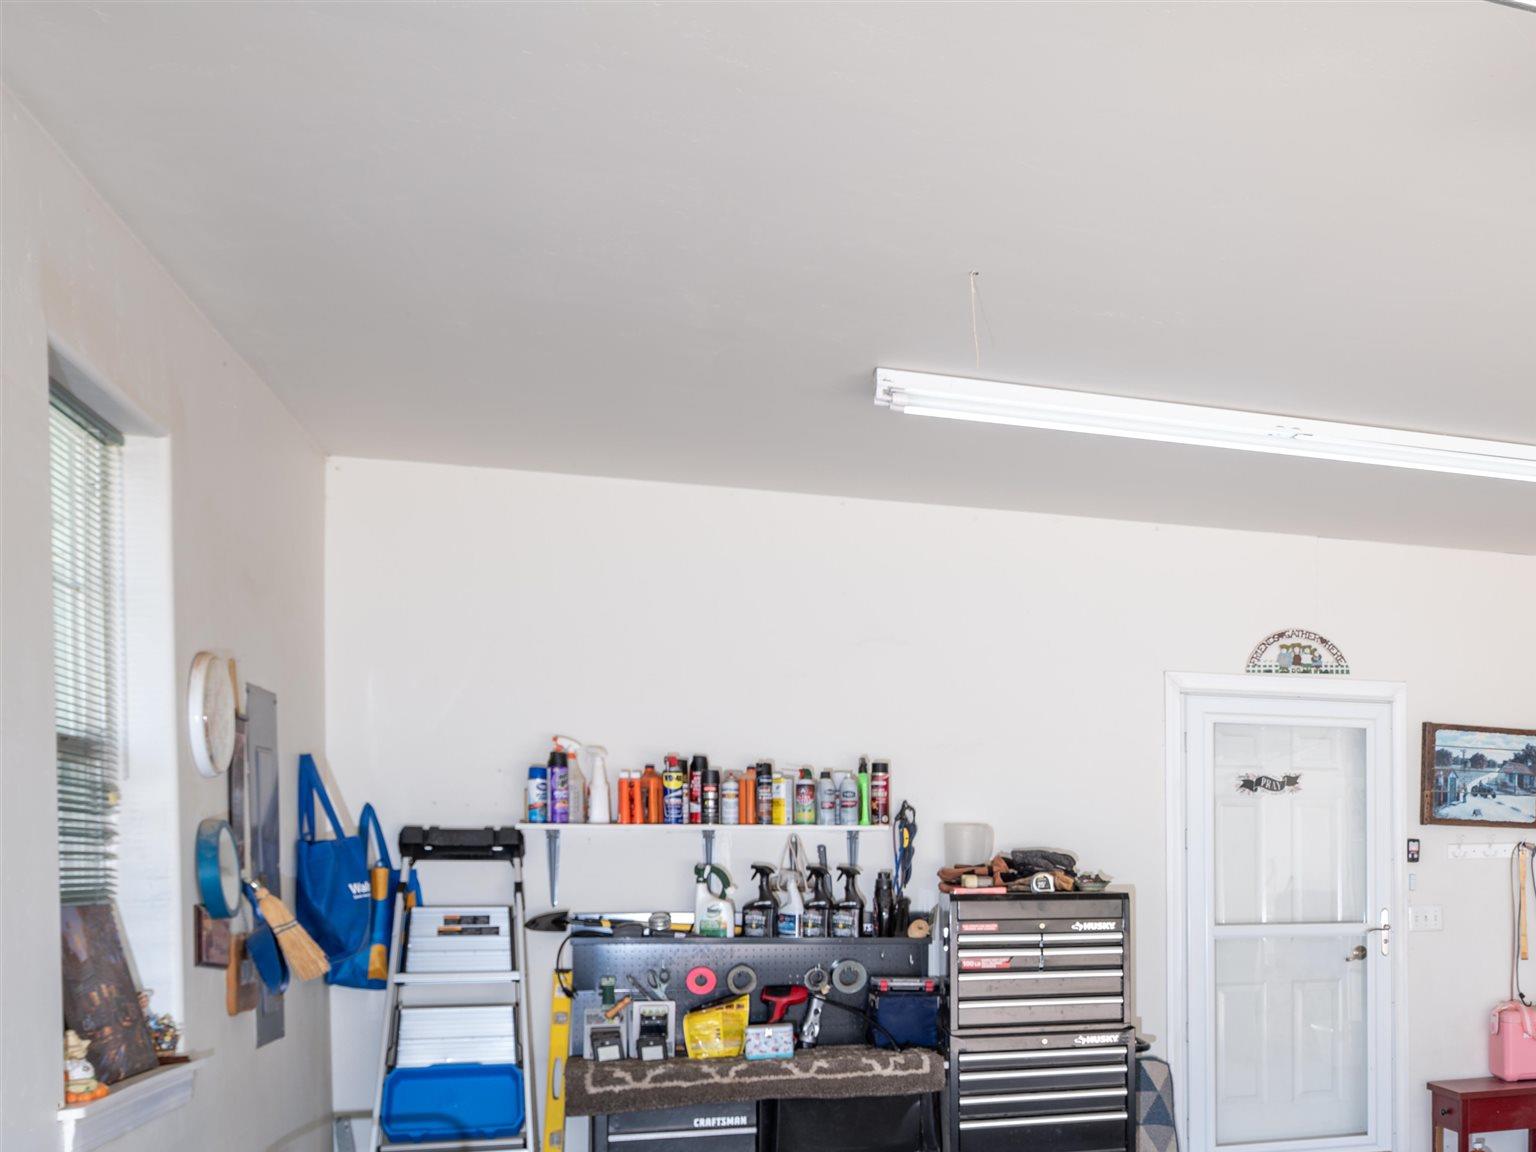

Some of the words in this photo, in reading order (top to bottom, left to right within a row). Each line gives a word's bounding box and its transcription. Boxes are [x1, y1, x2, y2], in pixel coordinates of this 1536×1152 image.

[1249, 632, 1281, 666] FRIENDS
[1284, 629, 1320, 642] GATHER
[1323, 640, 1347, 666] HERE
[1083, 921, 1116, 930] HUSKY
[1086, 1034, 1119, 1043] HUSKY
[693, 1115, 747, 1128] CRAFTSMAN
